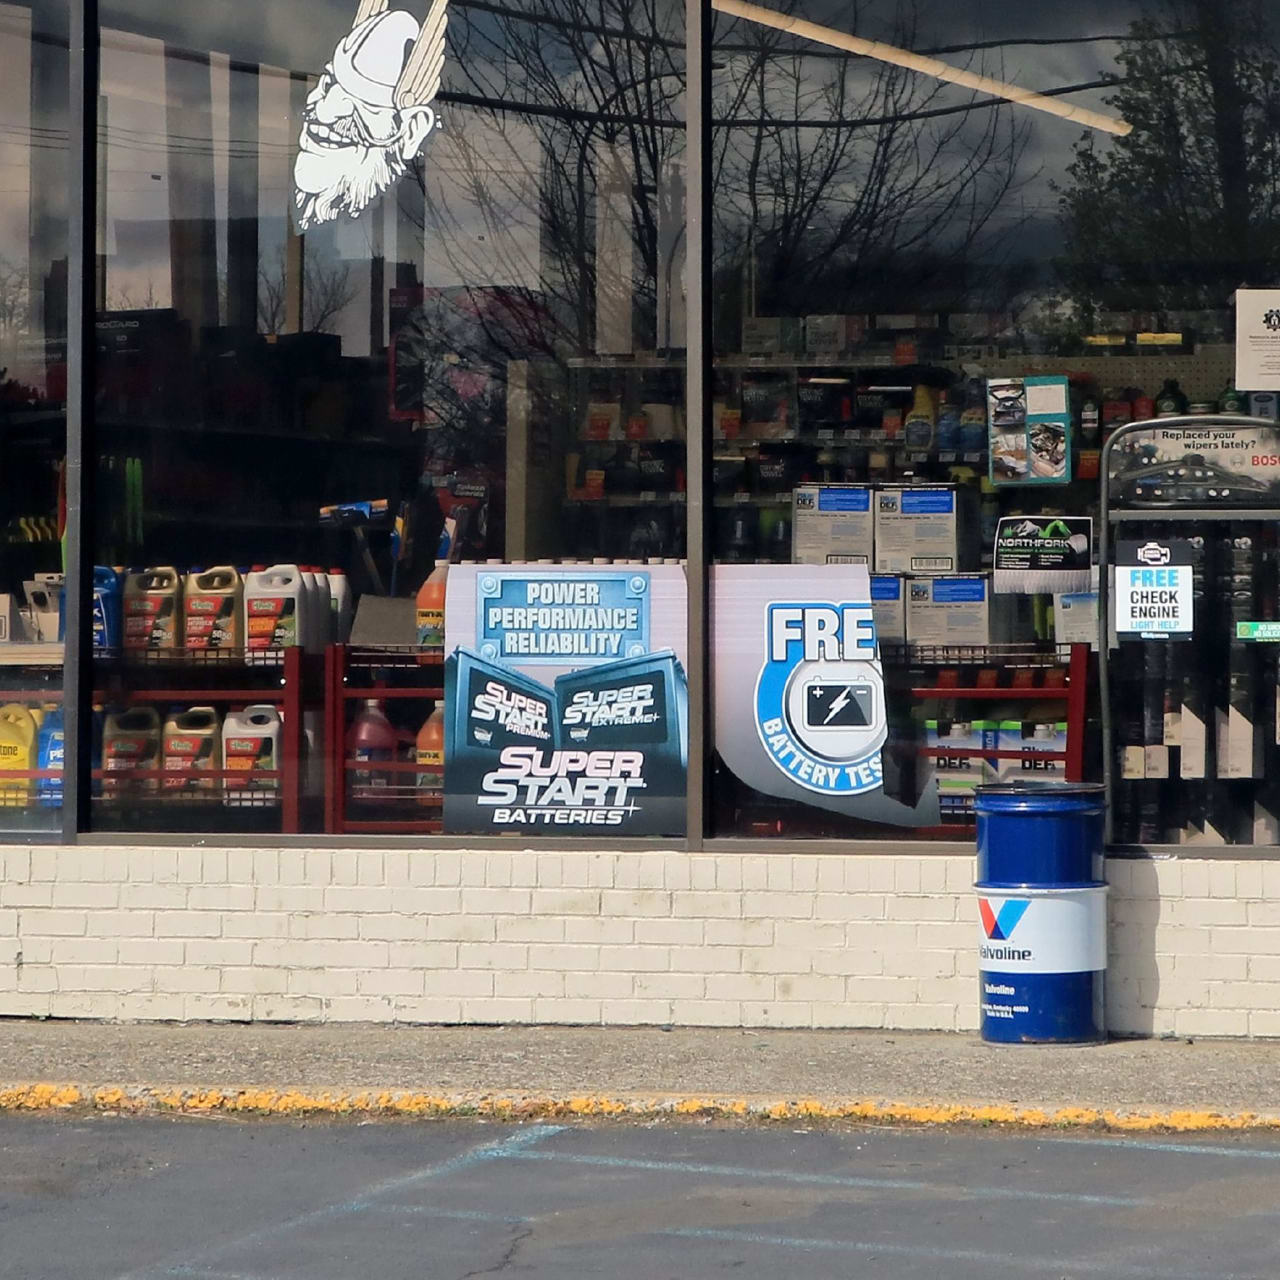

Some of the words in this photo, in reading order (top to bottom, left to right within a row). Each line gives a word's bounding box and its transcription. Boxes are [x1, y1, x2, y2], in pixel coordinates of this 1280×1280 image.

[1162, 431, 1210, 441] Replaced
[1212, 432, 1236, 441] your
[1184, 441, 1218, 450] wipers
[1221, 440, 1256, 450] lately?
[998, 539, 1070, 548] NORTHFORK
[1130, 569, 1179, 587] FREE
[527, 583, 600, 604] POWER
[1130, 590, 1179, 604] CHECK
[488, 608, 638, 629] PERFORMANCE
[1130, 606, 1179, 618] ENGINE
[772, 608, 881, 661] FRE
[1130, 621, 1155, 629] LIGHT
[1158, 621, 1179, 629] HELP
[505, 633, 621, 654] RELIABILITY
[484, 681, 547, 717] SUPER
[572, 684, 653, 707] SUPER
[471, 694, 549, 731] START
[563, 699, 654, 725] START
[498, 747, 644, 777] SUPER
[763, 718, 840, 788] BATTERY
[477, 772, 644, 806] START
[493, 808, 624, 825] BATTERIES
